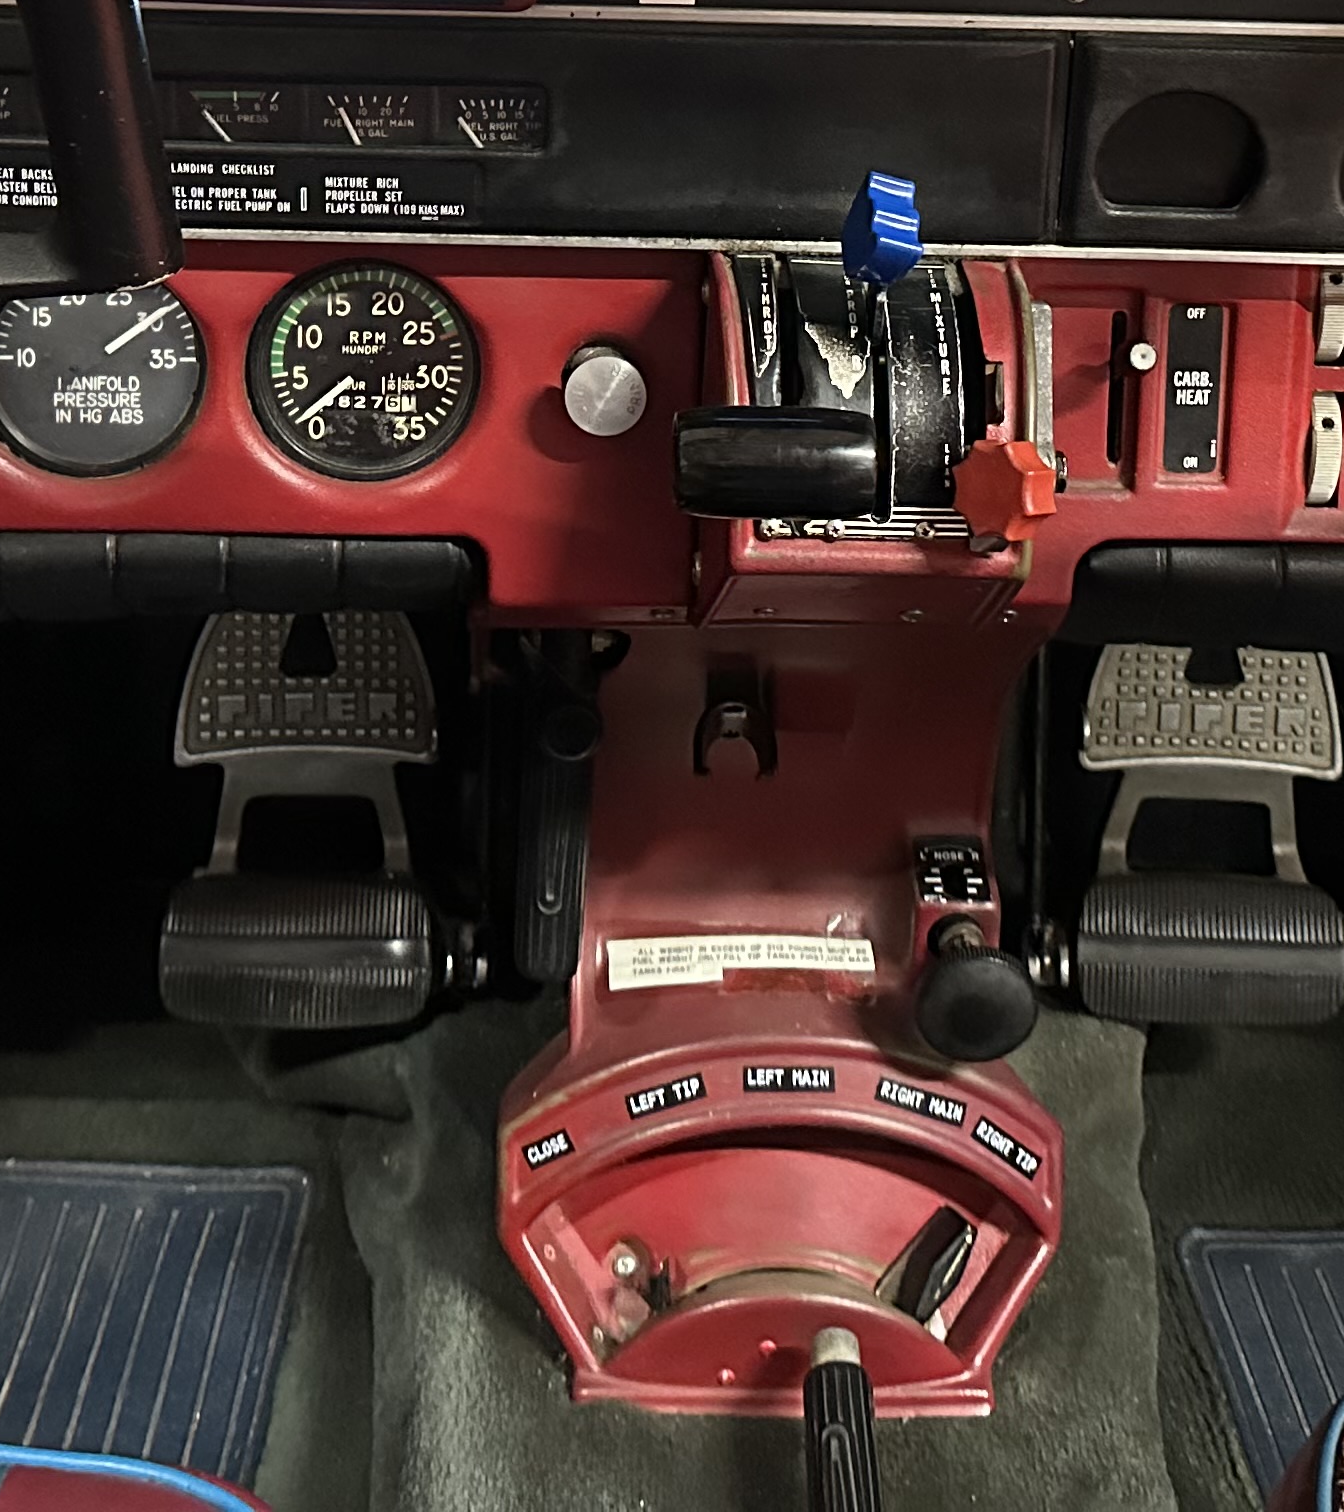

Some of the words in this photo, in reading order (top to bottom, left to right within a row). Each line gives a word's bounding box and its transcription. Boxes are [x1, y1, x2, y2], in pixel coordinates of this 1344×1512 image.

[171, 163, 214, 174] LANDING
[222, 164, 275, 176] CHECKLIST
[325, 177, 368, 188] MIXTURE
[377, 178, 398, 189] RICH
[191, 188, 204, 198] ON
[208, 188, 247, 199] PROPER
[252, 189, 277, 200] TANK
[325, 190, 377, 202] PROPELLER
[385, 191, 403, 202] SET
[218, 200, 242, 211] FUEL
[245, 201, 273, 212] PUMP
[277, 202, 290, 213] ON
[325, 203, 355, 214] FLAPS
[361, 204, 389, 214] DOWN
[394, 204, 416, 215] (109
[418, 206, 438, 215] KIAS
[440, 206, 464, 216] MAX)
[1187, 308, 1206, 319] OFF
[931, 292, 952, 395] MIXTURE
[1174, 372, 1213, 387] CARB.
[54, 393, 141, 407] PRESSURE
[1176, 389, 1211, 405] HEAT
[56, 409, 71, 423] IN
[80, 409, 102, 423] HG
[110, 409, 143, 424] ABS
[1184, 457, 1198, 468] ON
[218, 693, 397, 723] PIPER
[1117, 700, 1306, 737] PIPER
[747, 1069, 784, 1086] LEFT
[792, 1069, 830, 1086] MAIN
[629, 1089, 665, 1114] LEFT
[671, 1078, 700, 1100] TIP
[880, 1081, 924, 1109] RIGHT
[929, 1098, 963, 1123] MAIN
[527, 1134, 568, 1163] CLOSE
[976, 1121, 1014, 1157] RIGHT
[1016, 1148, 1038, 1173] TIP
